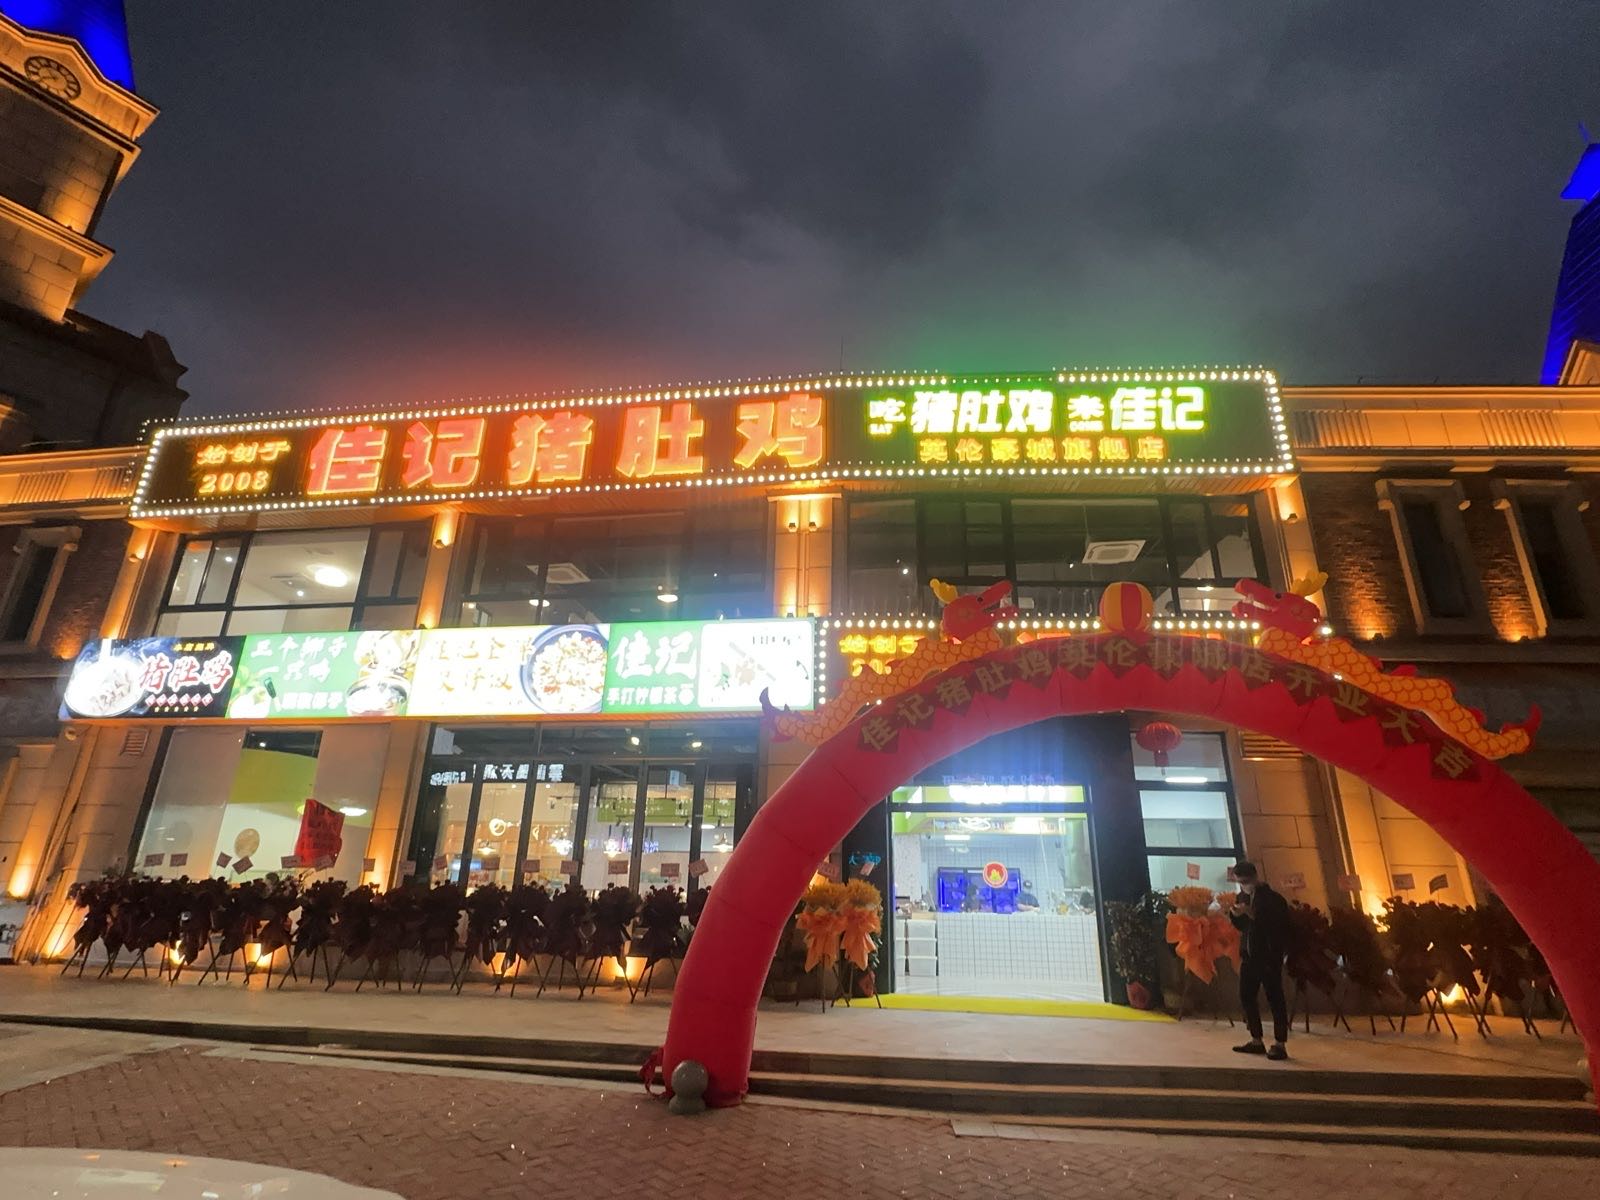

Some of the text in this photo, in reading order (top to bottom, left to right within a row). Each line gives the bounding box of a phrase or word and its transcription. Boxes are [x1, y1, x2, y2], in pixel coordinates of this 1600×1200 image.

[196, 440, 292, 466] 始创于
[306, 393, 823, 496] 佳记猪肚鸡
[919, 436, 1165, 462] 英伦豪城旗舰店
[198, 470, 270, 495] 2008
[250, 635, 348, 662] 三个椰子
[611, 629, 697, 680] 佳记
[839, 634, 920, 654] 始创于
[138, 649, 234, 695] 猪肚鸡
[607, 686, 678, 706] 手打柠檬茶
